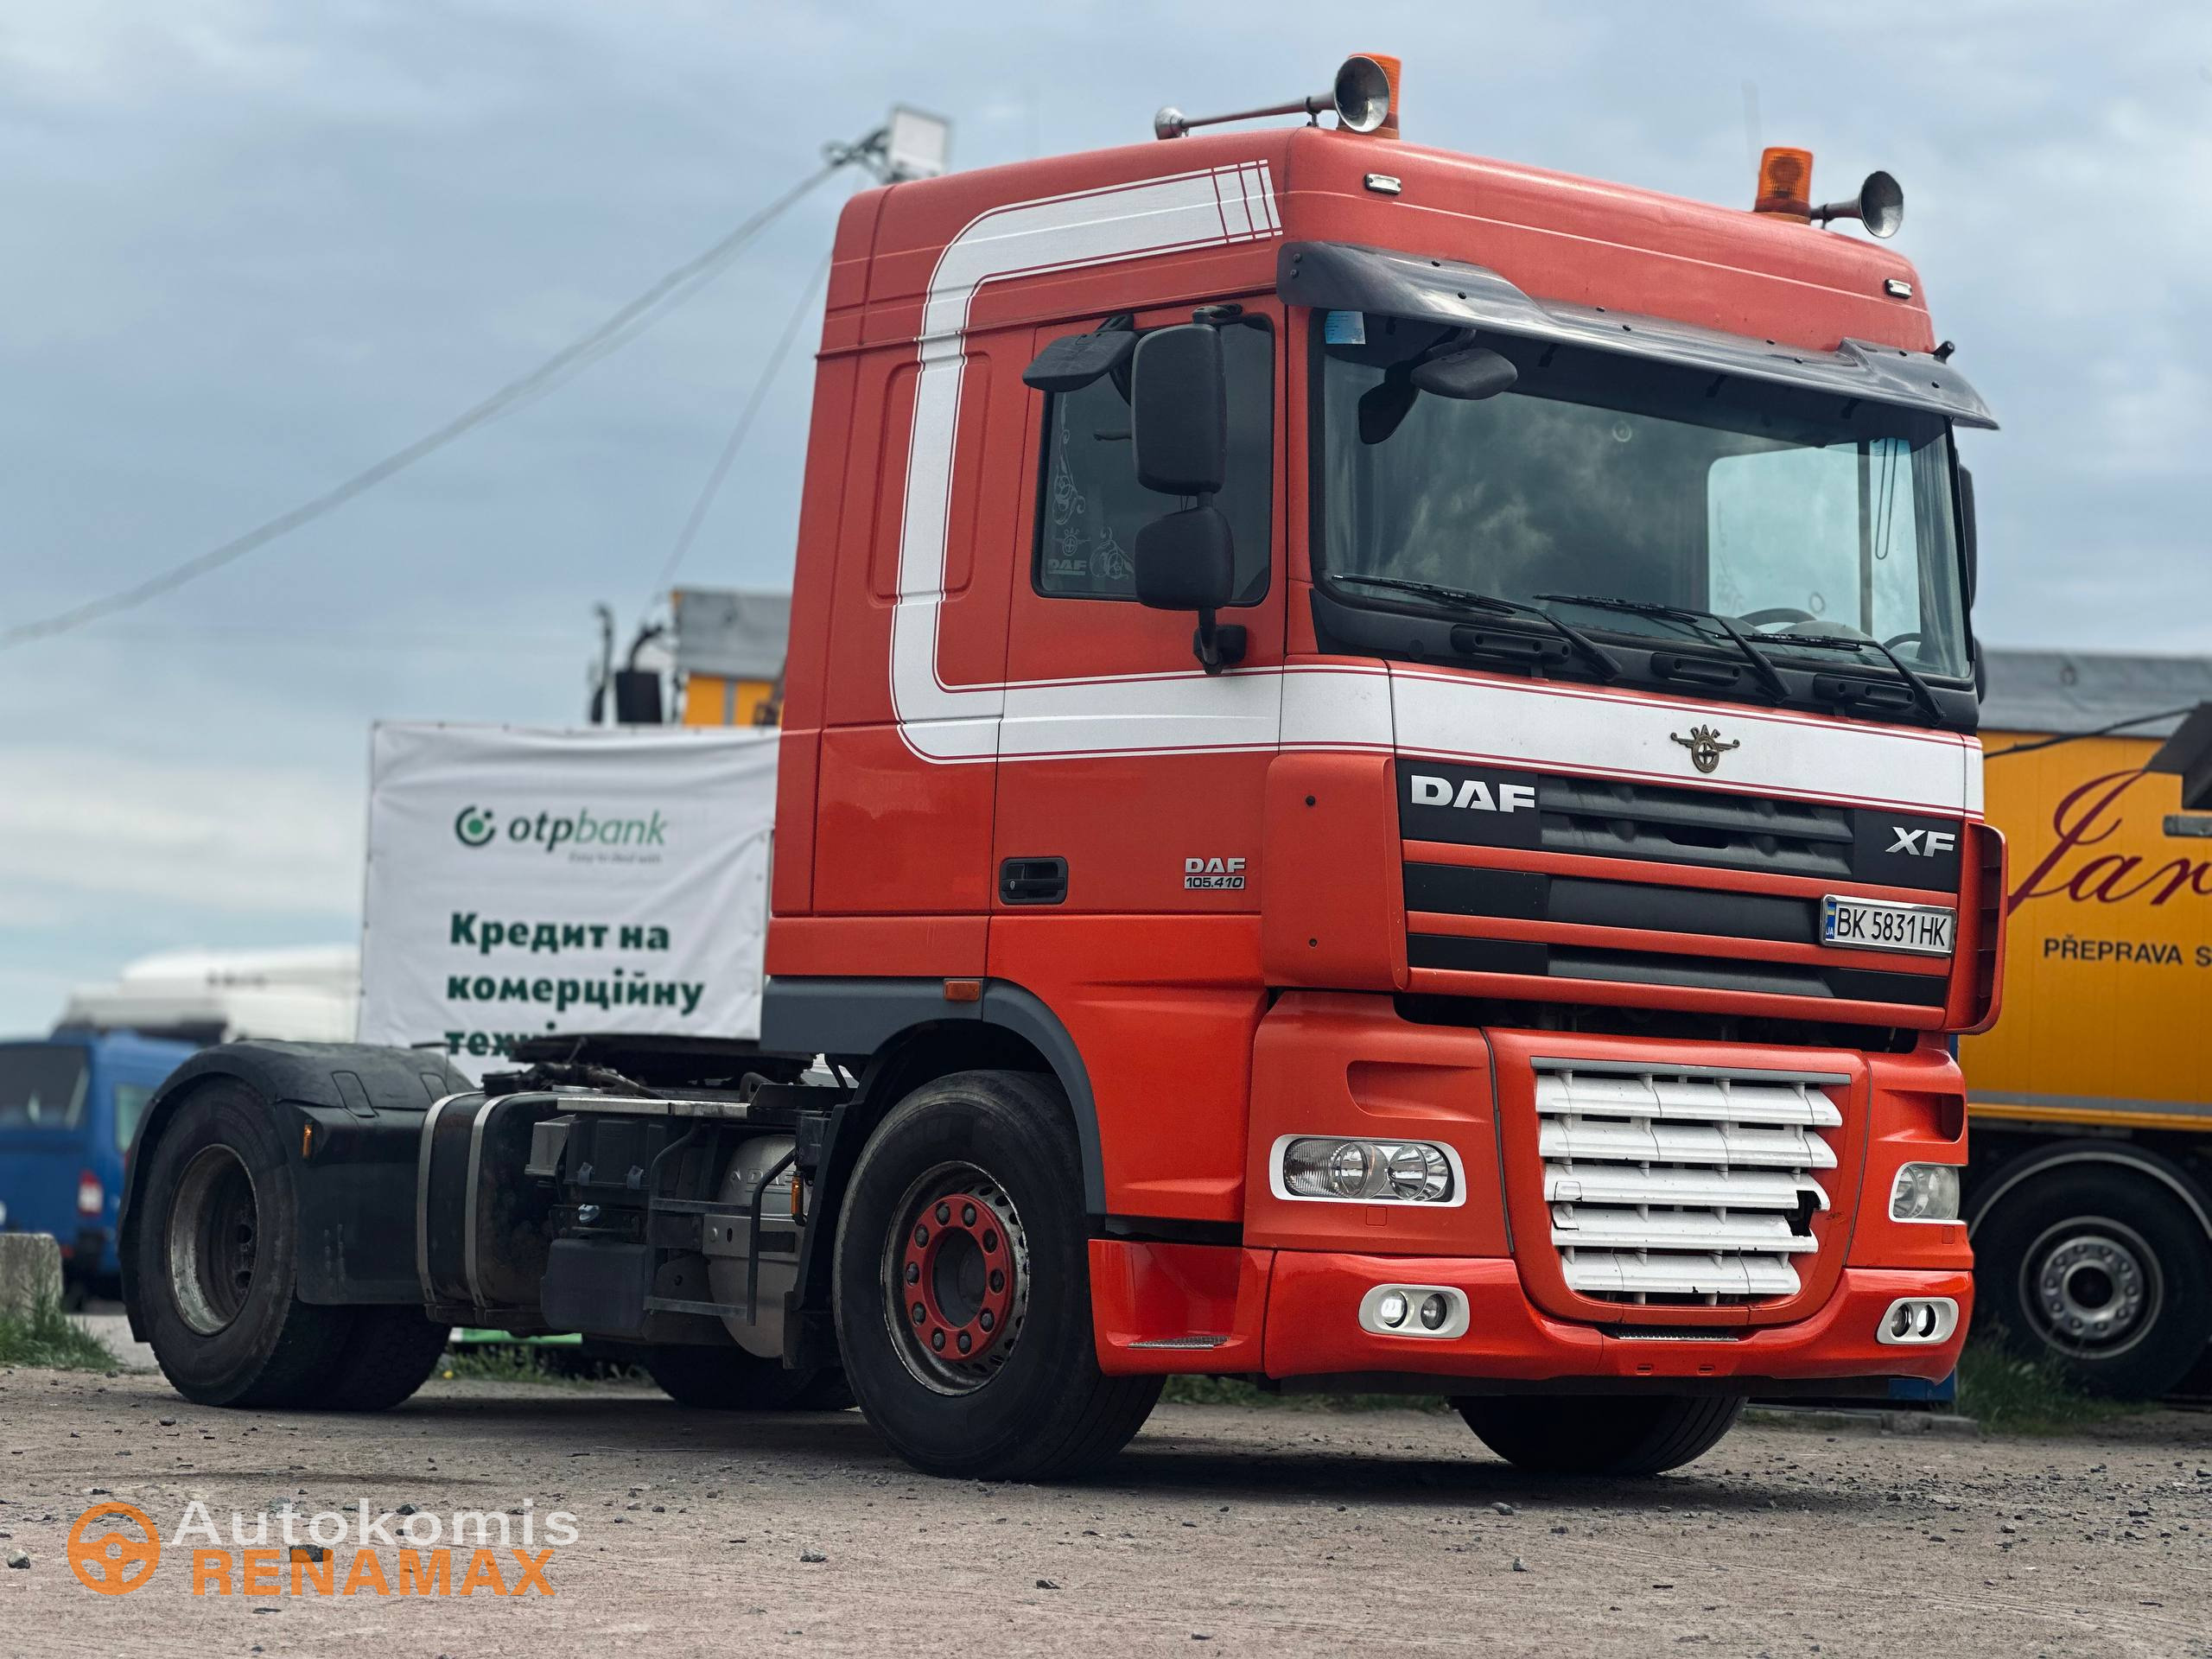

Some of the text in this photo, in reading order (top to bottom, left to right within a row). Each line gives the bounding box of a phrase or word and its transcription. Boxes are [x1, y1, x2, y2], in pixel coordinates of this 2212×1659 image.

[1048, 559, 1087, 570] DAF
[1411, 775, 1535, 813] DAF
[508, 808, 668, 853] otpbank
[1885, 826, 1956, 857] XF
[1185, 857, 1246, 873] DAF
[1186, 877, 1243, 887] 105.410
[450, 912, 670, 955] Кредит на
[1837, 907, 1947, 946] BK 5831 HK
[2044, 933, 2183, 965] PŘEPRAVA
[447, 967, 705, 1017] комерційну
